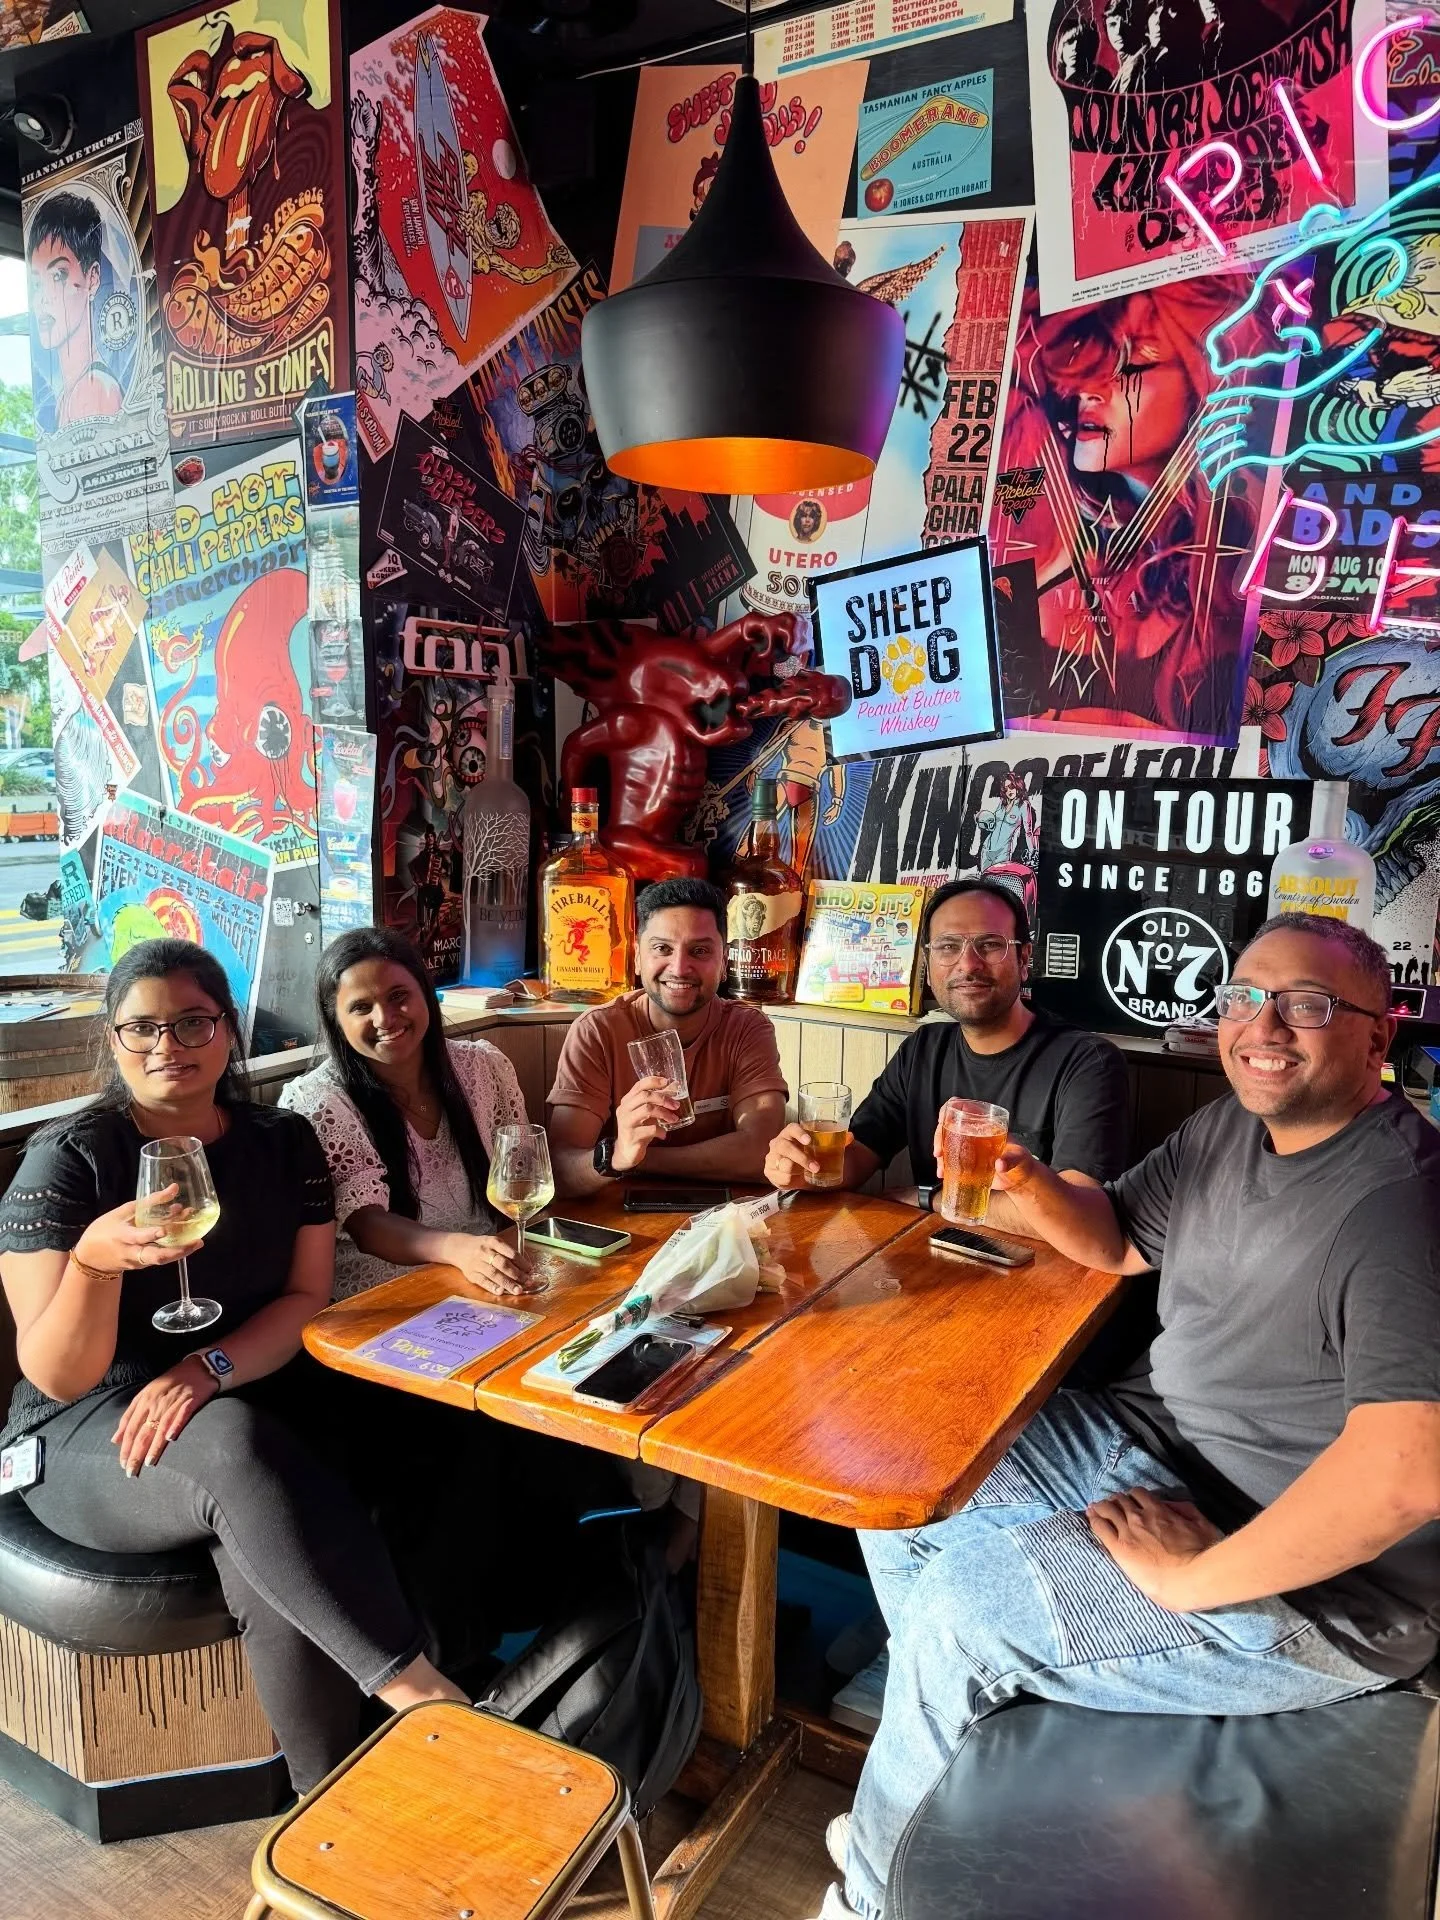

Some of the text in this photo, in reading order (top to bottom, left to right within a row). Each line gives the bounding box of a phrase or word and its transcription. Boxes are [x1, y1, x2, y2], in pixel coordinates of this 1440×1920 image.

[891, 8, 964, 33] THE TAMWORTH
[892, 0, 943, 14] SOUTHGAT
[892, 1, 958, 23] WELDER'S DOG
[668, 71, 737, 144] SWEET
[863, 74, 988, 115] TASMANIAN FANCY APPLES
[65, 147, 84, 165] WE
[82, 131, 122, 158] TRUST
[869, 103, 980, 173] BOOMERANG
[912, 153, 953, 171] AUSTRALIA
[900, 194, 919, 208] JONES
[961, 179, 988, 194] HOBART
[172, 359, 247, 414] ROLLING
[254, 330, 330, 398] STONES
[942, 379, 998, 420] FEB
[251, 408, 268, 421] ROLL
[360, 405, 388, 453] STADIUM
[946, 422, 992, 463] 22
[416, 452, 477, 498] CLASH
[930, 474, 983, 504] PALA
[1009, 469, 1034, 485] The
[996, 479, 1046, 503] Pickled
[1302, 482, 1423, 506] AND
[129, 460, 297, 563] RED HOT
[429, 478, 507, 545] GASSERS
[927, 504, 979, 534] GHIA
[1003, 499, 1034, 516] Bear
[137, 543, 197, 597] CHILI
[197, 495, 307, 572] PEPPERS
[769, 547, 839, 569] UTERO
[705, 563, 740, 597] ARENA
[1329, 555, 1362, 576] AUG
[1090, 577, 1111, 585] THE
[845, 576, 952, 644] SHEEP
[1052, 588, 1145, 613] MDNA
[857, 687, 962, 720] Peanut Butter
[879, 710, 941, 737] Whiskey
[1060, 788, 1294, 856] ON TOUR
[900, 875, 920, 887] WITH
[1058, 862, 1171, 893] SINCE
[1277, 874, 1360, 897] ABSOLUT
[551, 892, 610, 922] FIREBALL
[815, 887, 915, 916] WHO IS IT?
[1273, 885, 1361, 912] Country of Sweden
[1142, 917, 1191, 938] OLD
[761, 947, 786, 964] TRACE
[1393, 941, 1412, 951] 22
[1127, 997, 1198, 1019] BRAND
